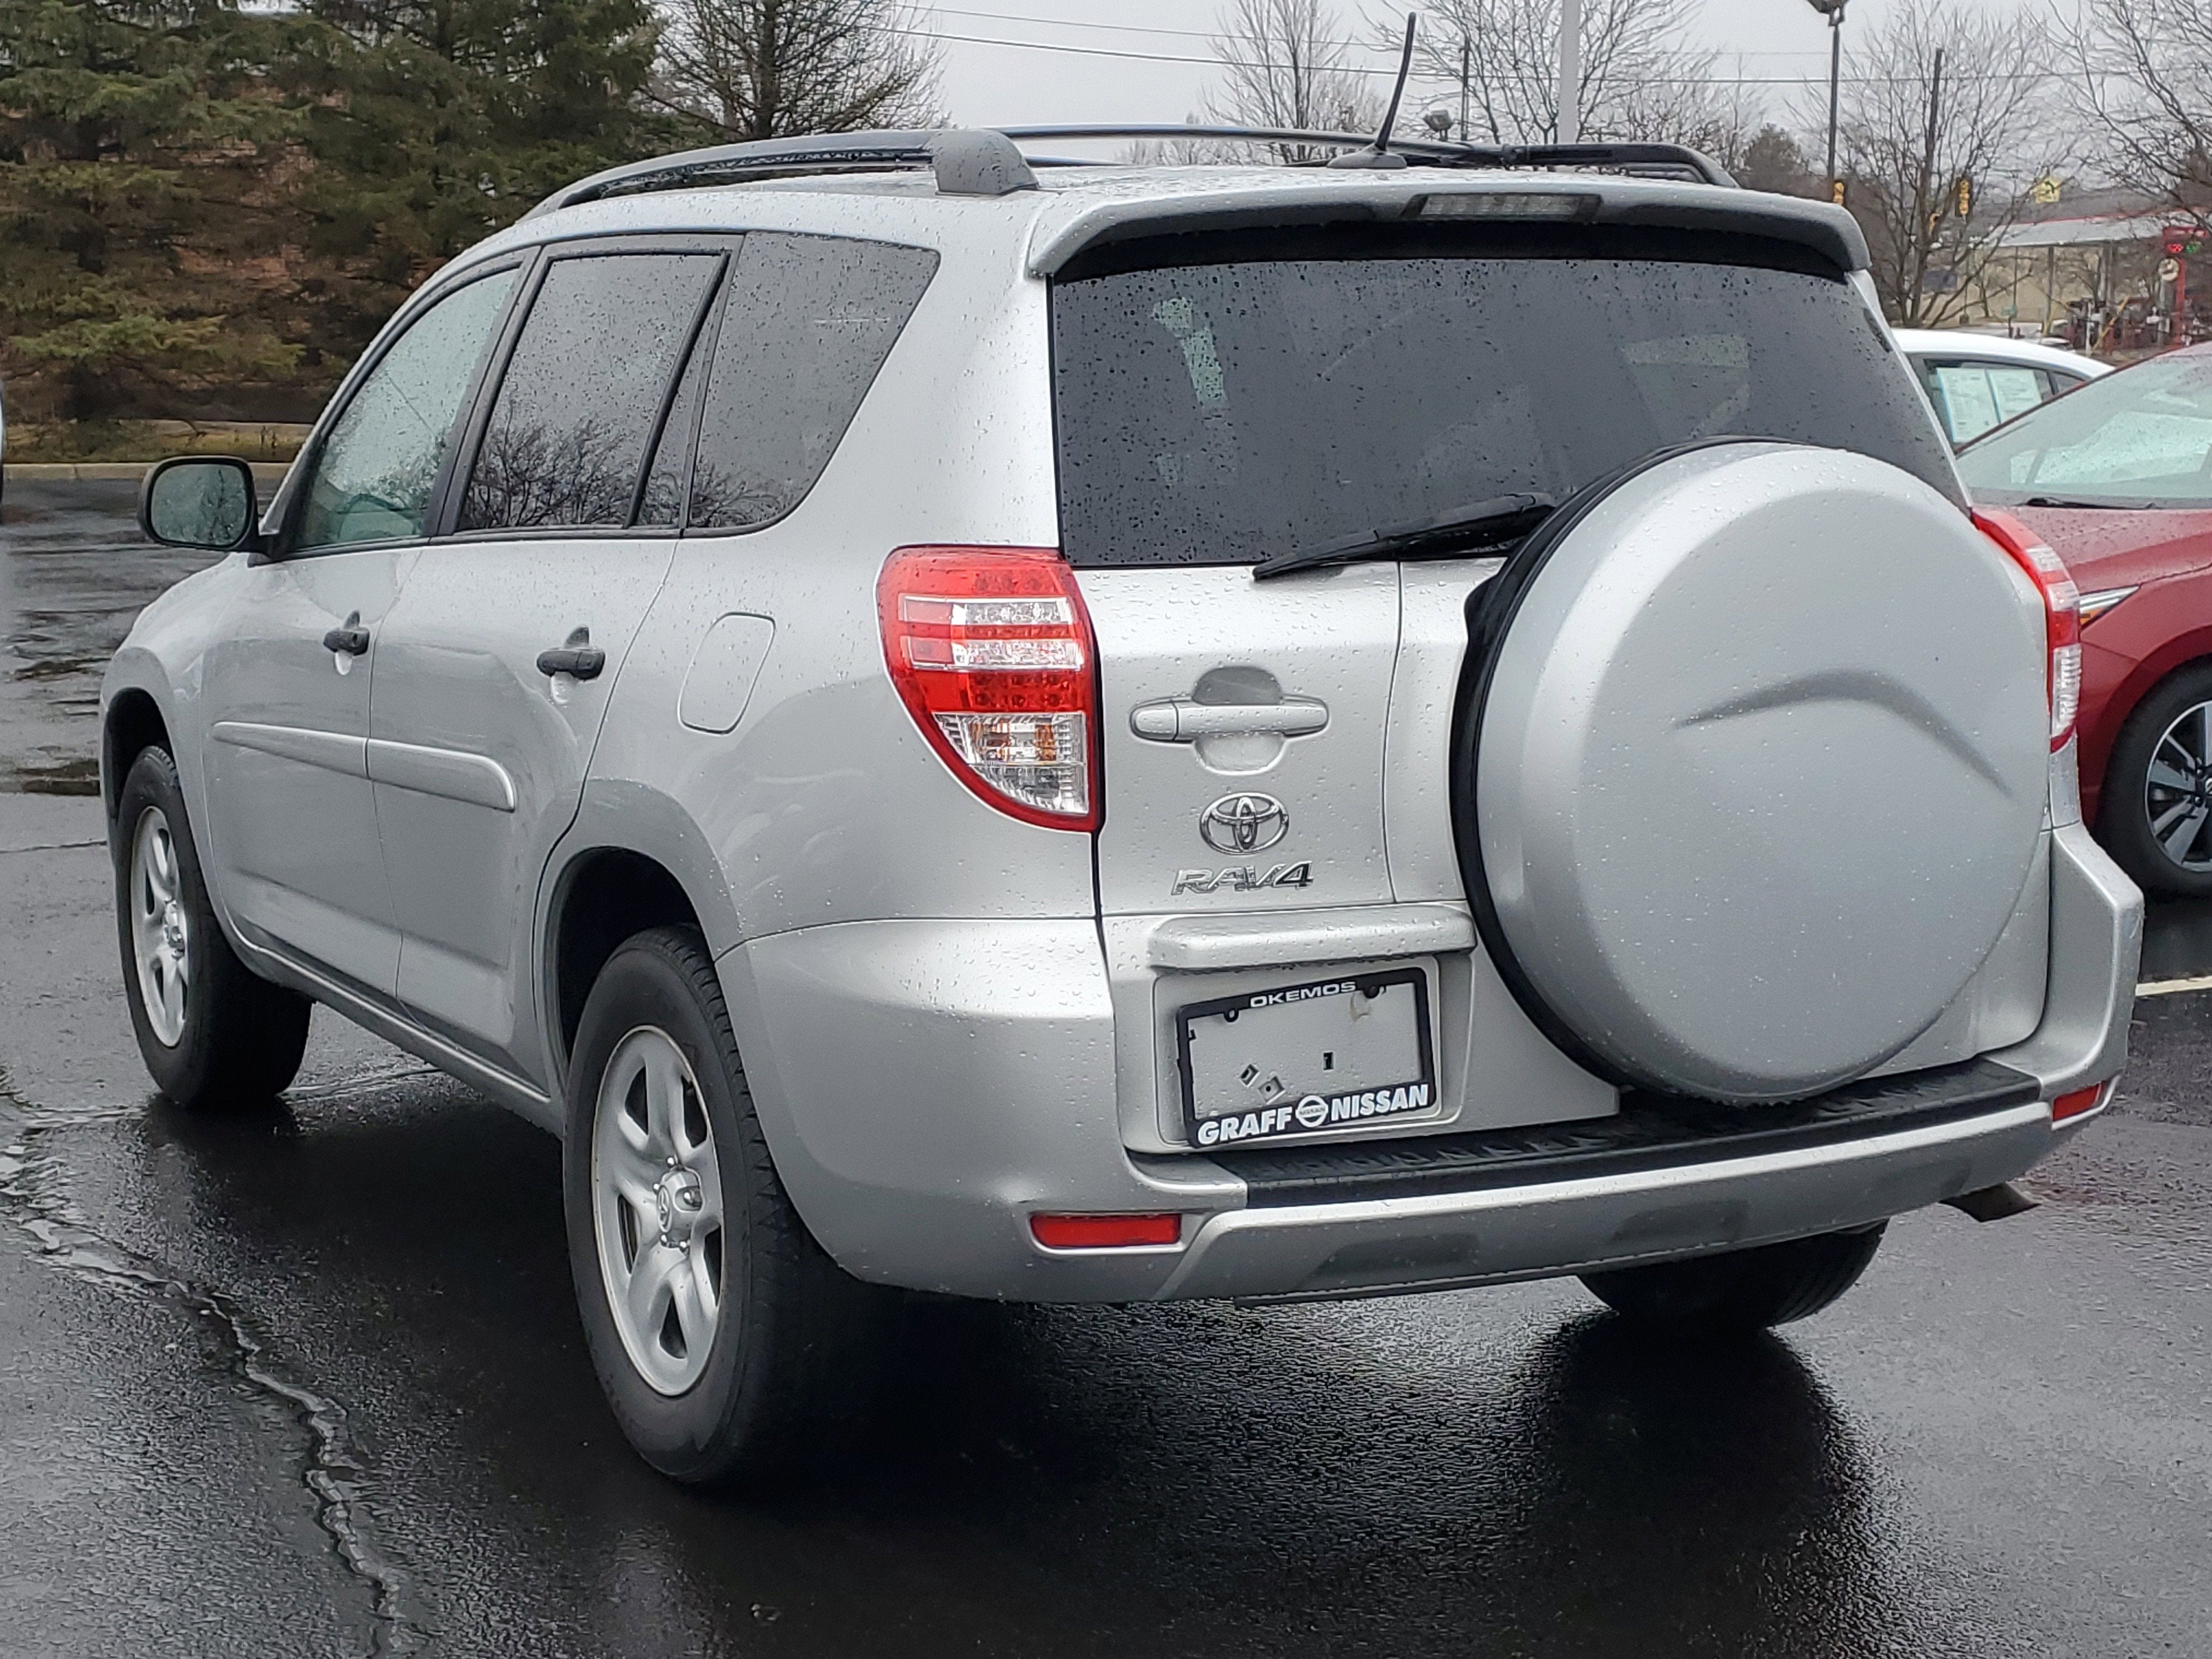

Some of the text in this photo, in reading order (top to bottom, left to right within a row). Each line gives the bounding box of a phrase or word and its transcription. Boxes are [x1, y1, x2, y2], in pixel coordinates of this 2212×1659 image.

[1171, 860, 1314, 895] RAV4
[1250, 981, 1356, 1008] OKEMOS
[1198, 1084, 1429, 1145] GRAFF NISSAN
